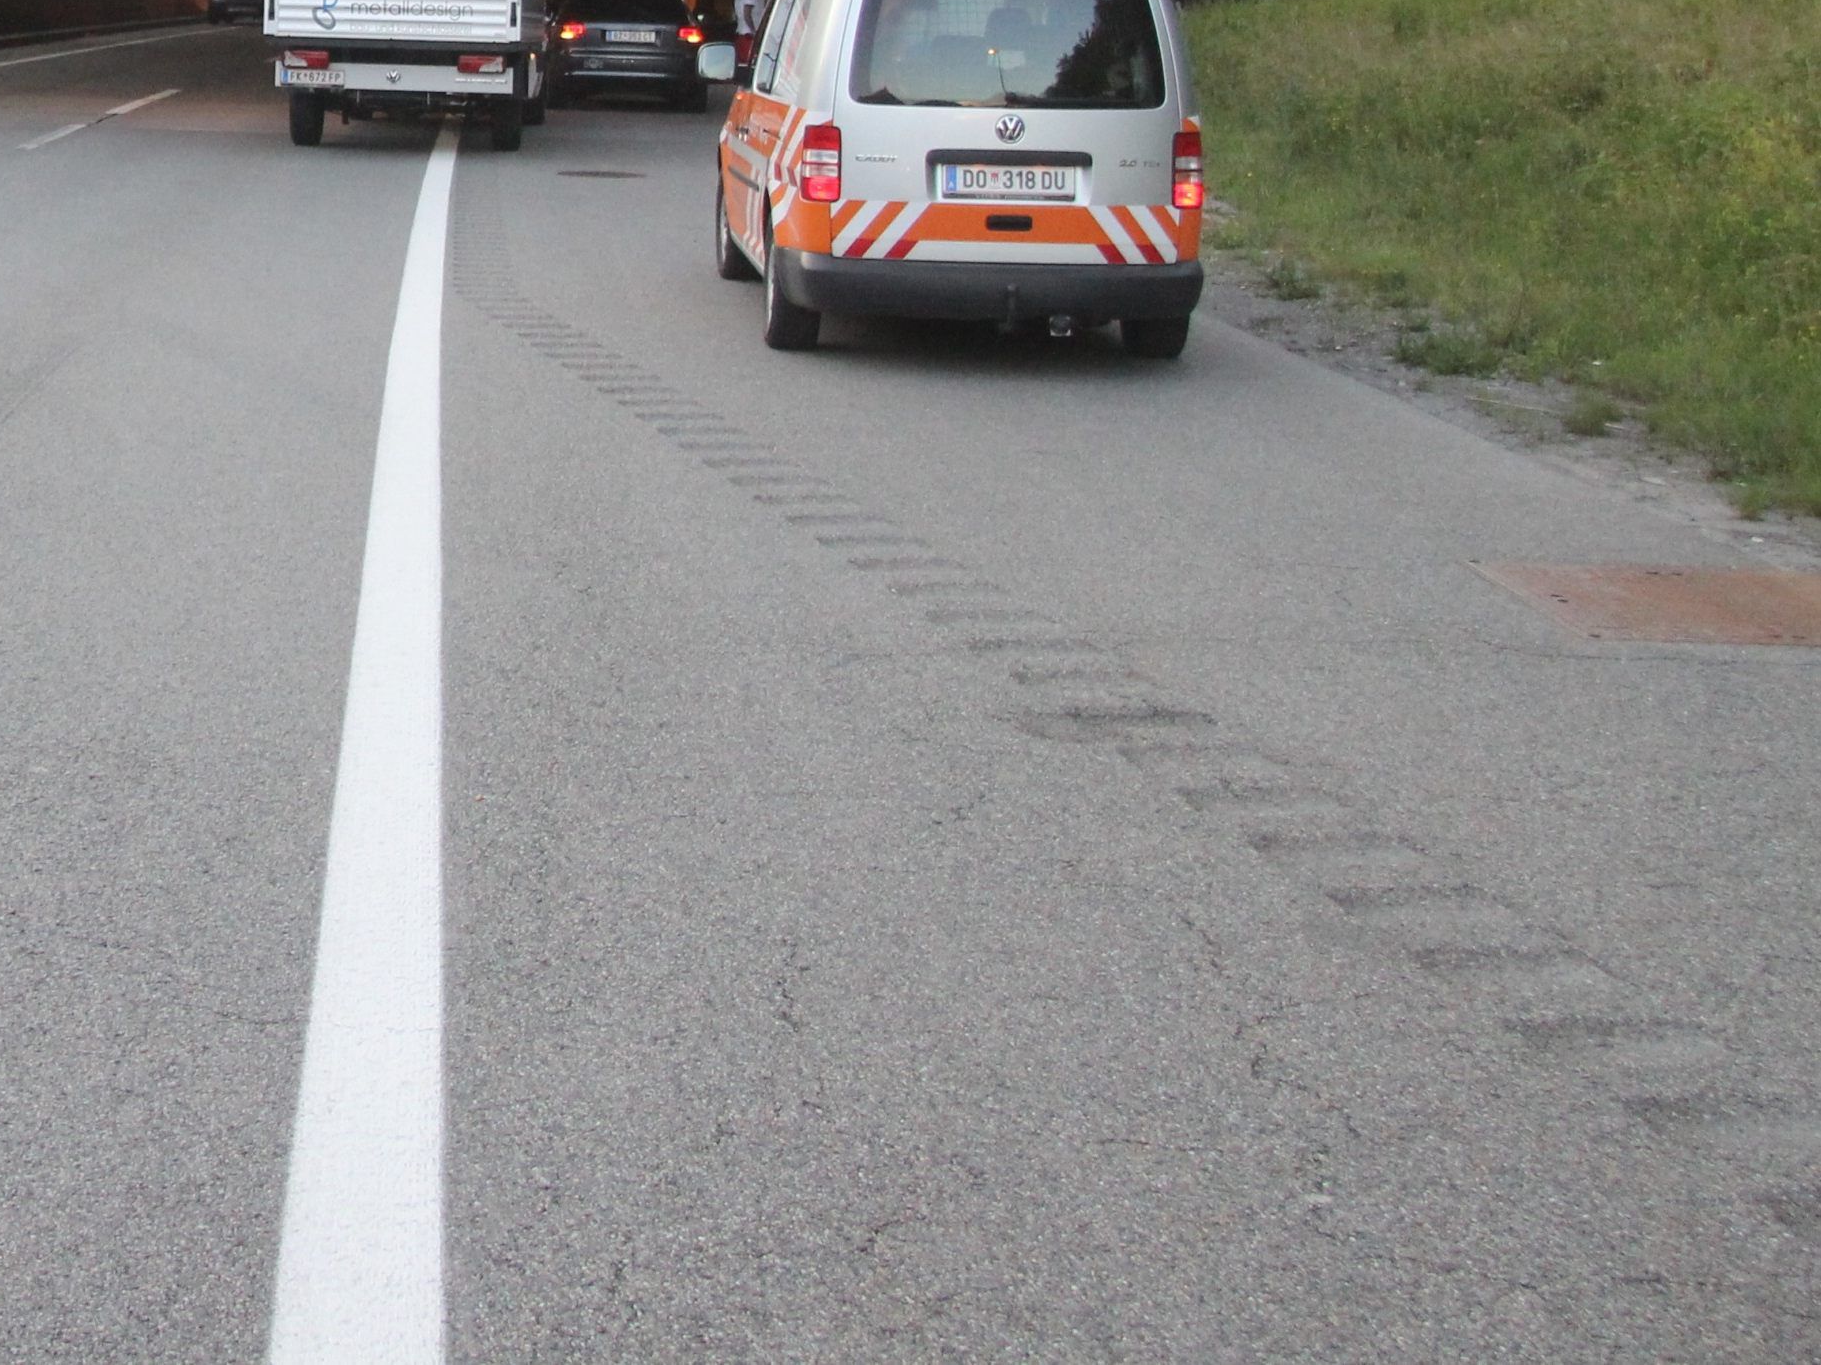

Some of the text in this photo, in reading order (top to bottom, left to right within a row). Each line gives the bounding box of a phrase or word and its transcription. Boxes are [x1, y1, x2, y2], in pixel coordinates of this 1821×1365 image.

[962, 169, 987, 190] DO
[1002, 170, 1036, 191] 318
[1041, 171, 1067, 191] DU
